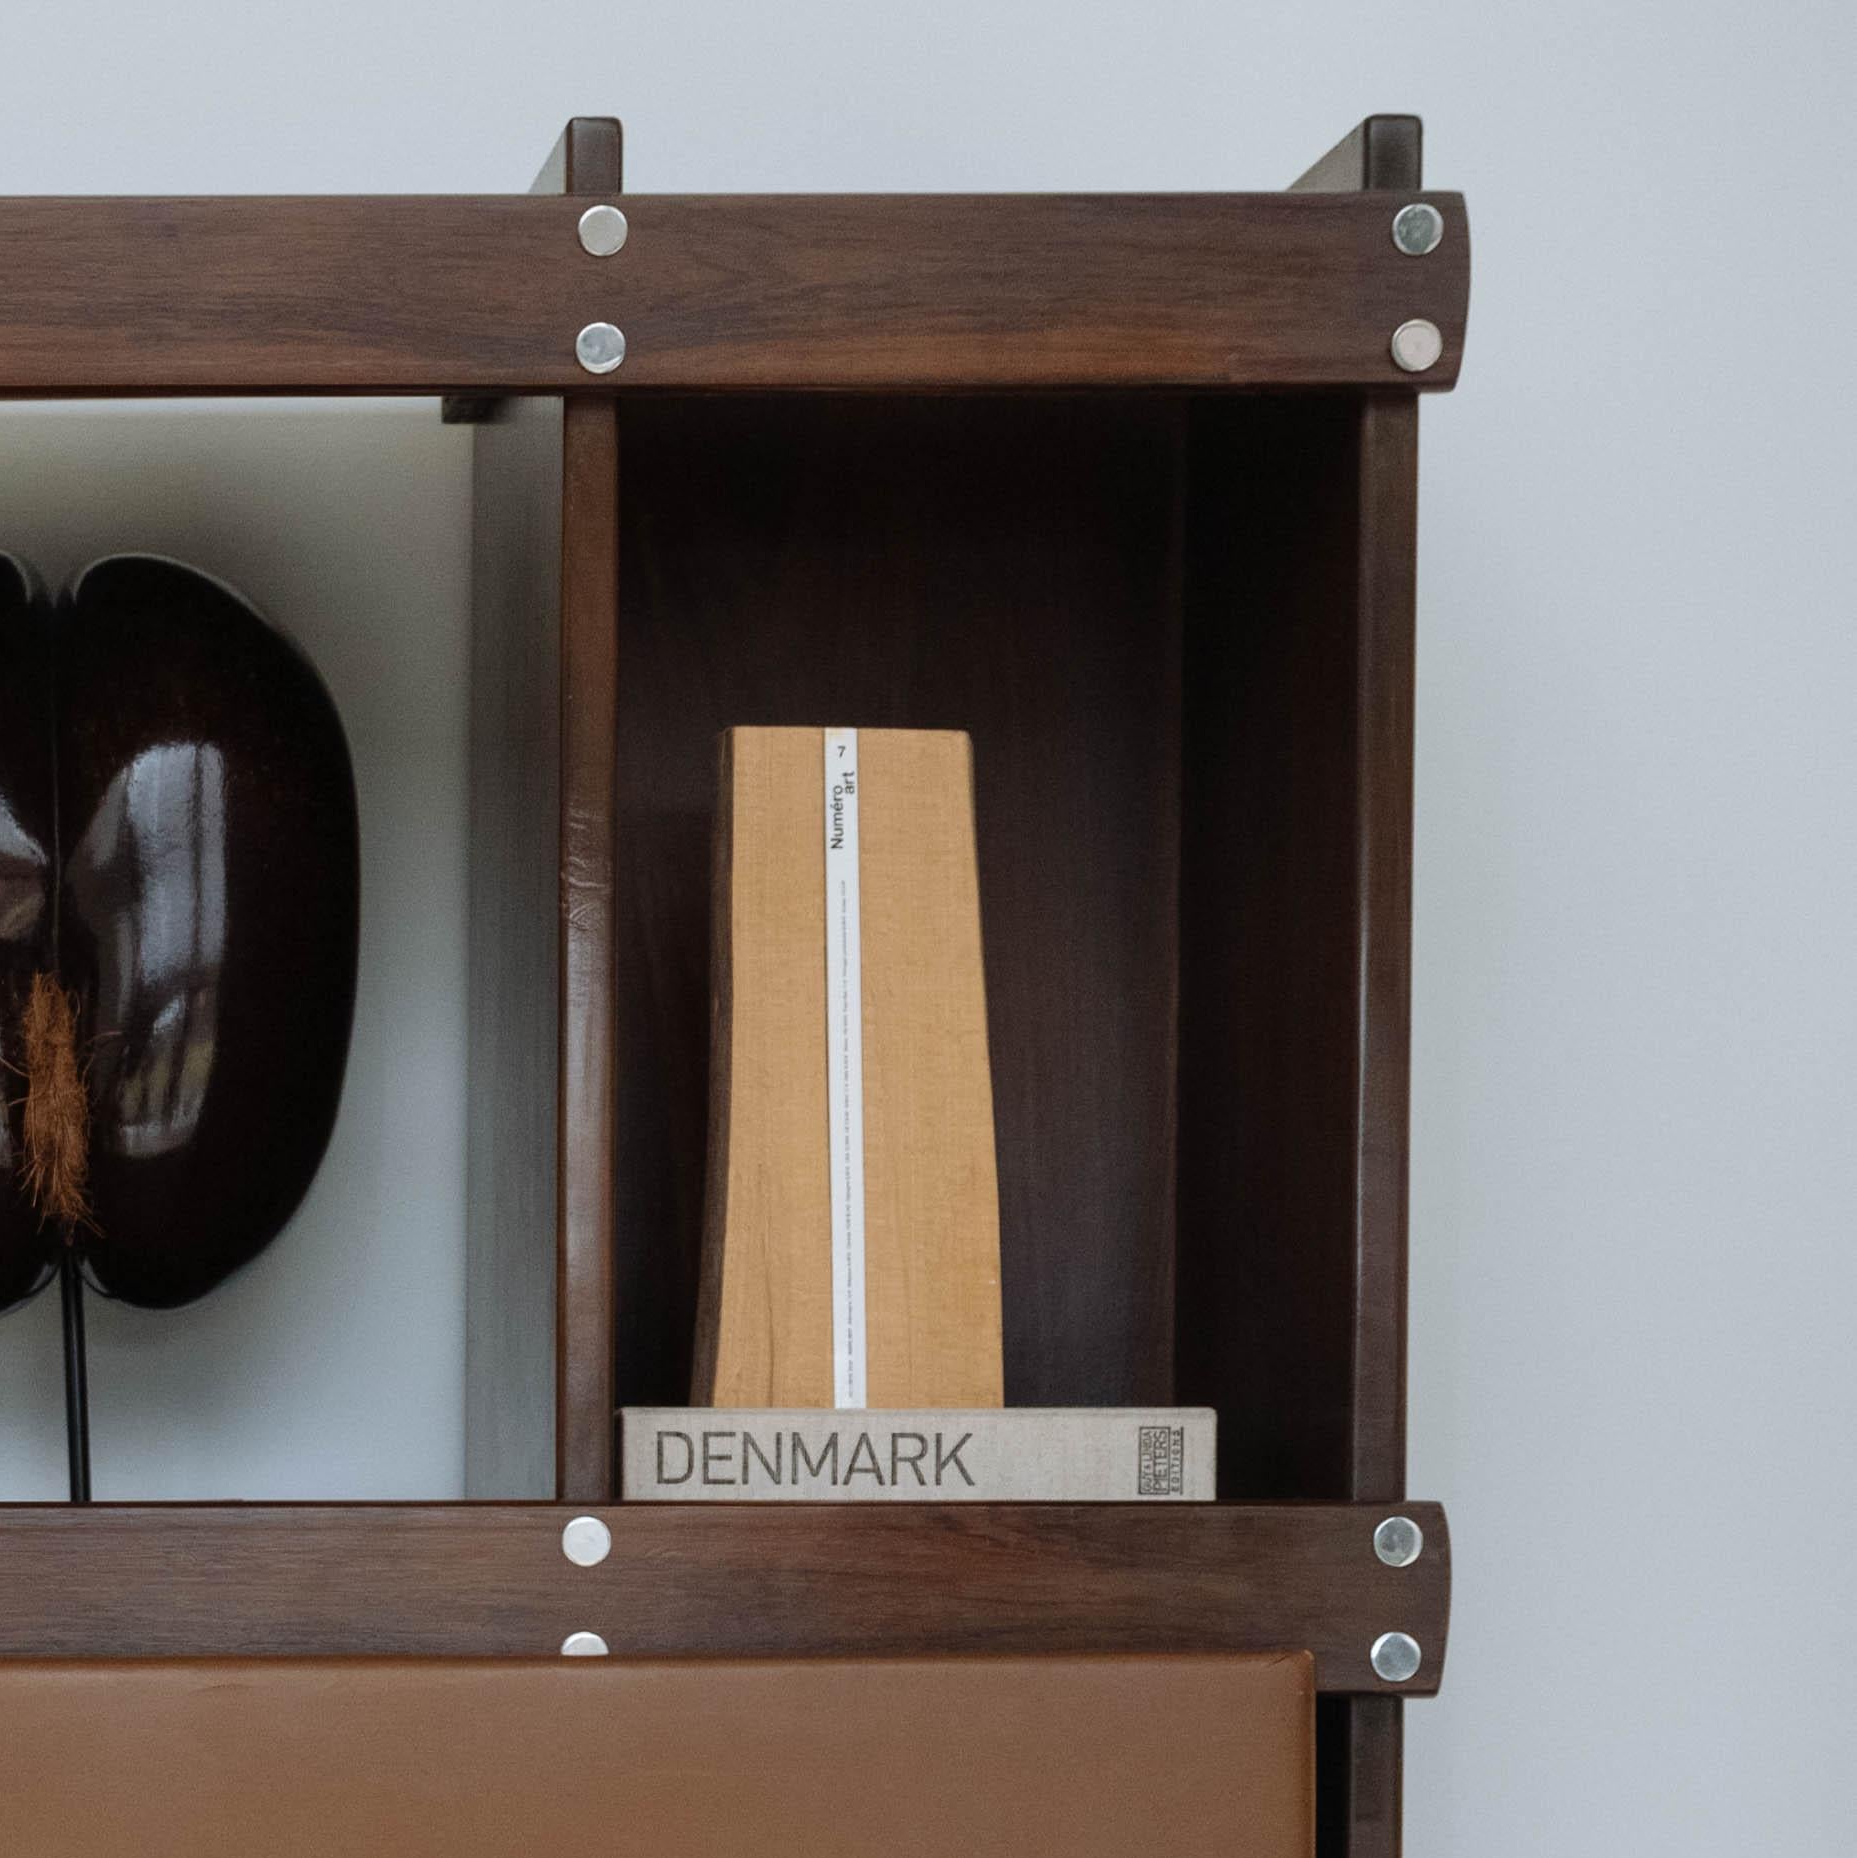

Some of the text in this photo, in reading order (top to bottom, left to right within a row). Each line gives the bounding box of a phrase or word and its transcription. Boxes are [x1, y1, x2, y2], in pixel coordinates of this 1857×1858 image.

[837, 745, 846, 758] 7
[842, 771, 855, 795] art
[830, 785, 844, 849] Numéro
[656, 1431, 975, 1486] DENMARK
[1153, 1430, 1167, 1492] PIETERS
[1171, 1430, 1180, 1493] EDITIONS
